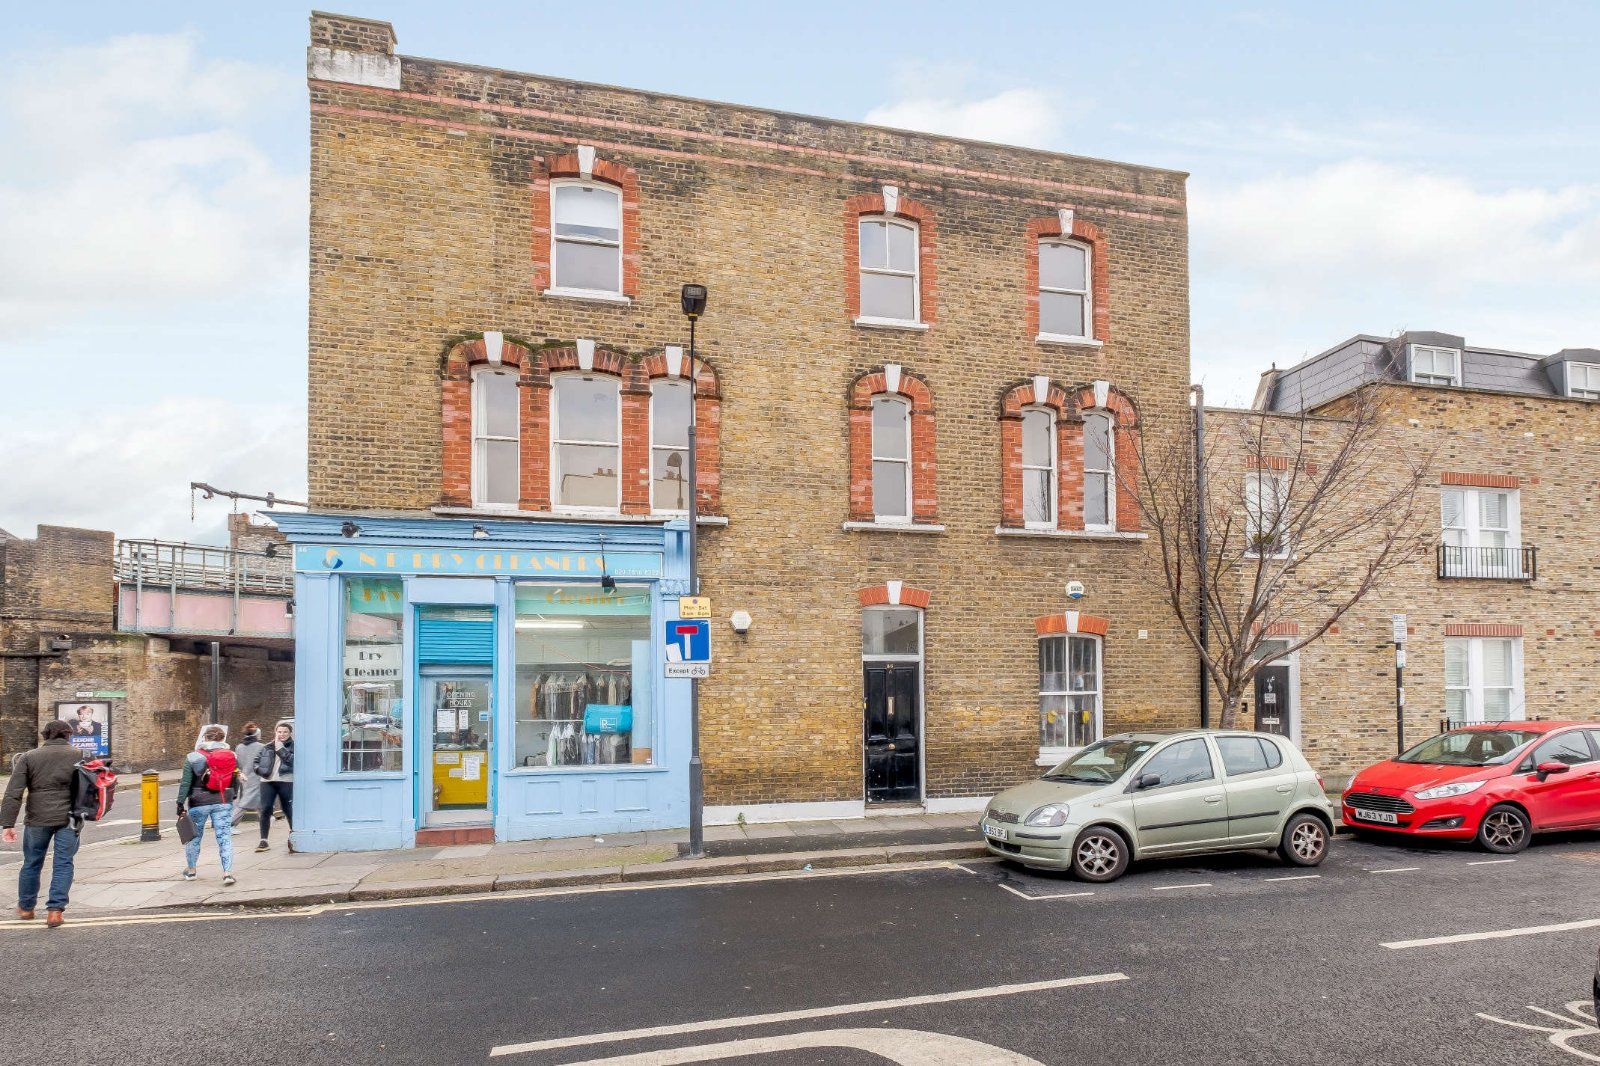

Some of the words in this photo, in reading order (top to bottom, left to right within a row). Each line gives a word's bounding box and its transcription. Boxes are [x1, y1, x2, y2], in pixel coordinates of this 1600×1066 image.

[359, 651, 382, 661] Dry
[345, 667, 401, 678] Cleaner
[1377, 813, 1394, 822] YJD
